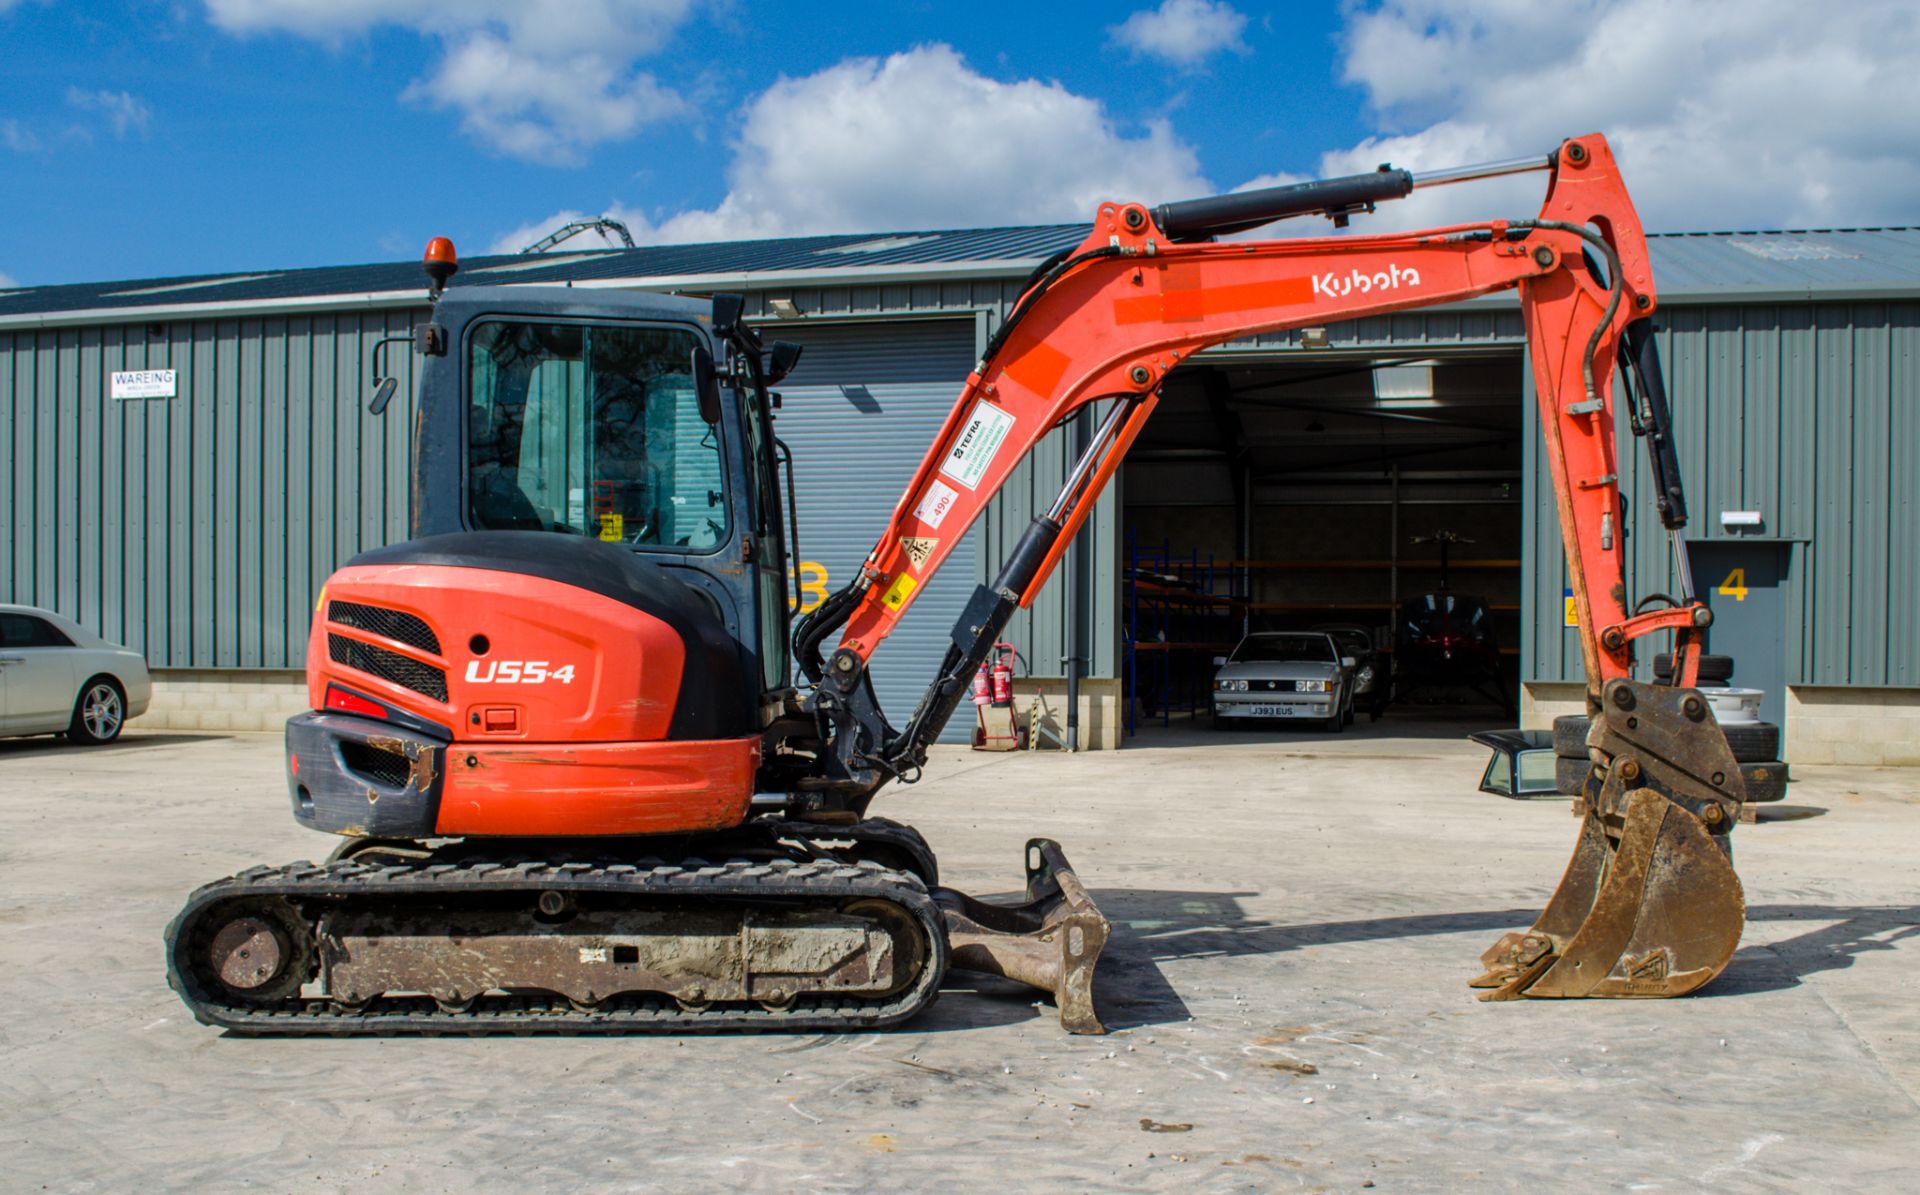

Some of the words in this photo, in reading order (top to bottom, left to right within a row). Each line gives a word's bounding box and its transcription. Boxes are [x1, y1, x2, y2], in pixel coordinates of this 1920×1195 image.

[1312, 263, 1420, 297] Kubota
[115, 371, 172, 384] WAREING
[960, 419, 981, 448] TEFRA
[933, 496, 949, 516] 490
[789, 561, 829, 614] 3
[1718, 568, 1748, 601] 4
[465, 660, 575, 684] U55-4
[1276, 707, 1293, 715] EUS
